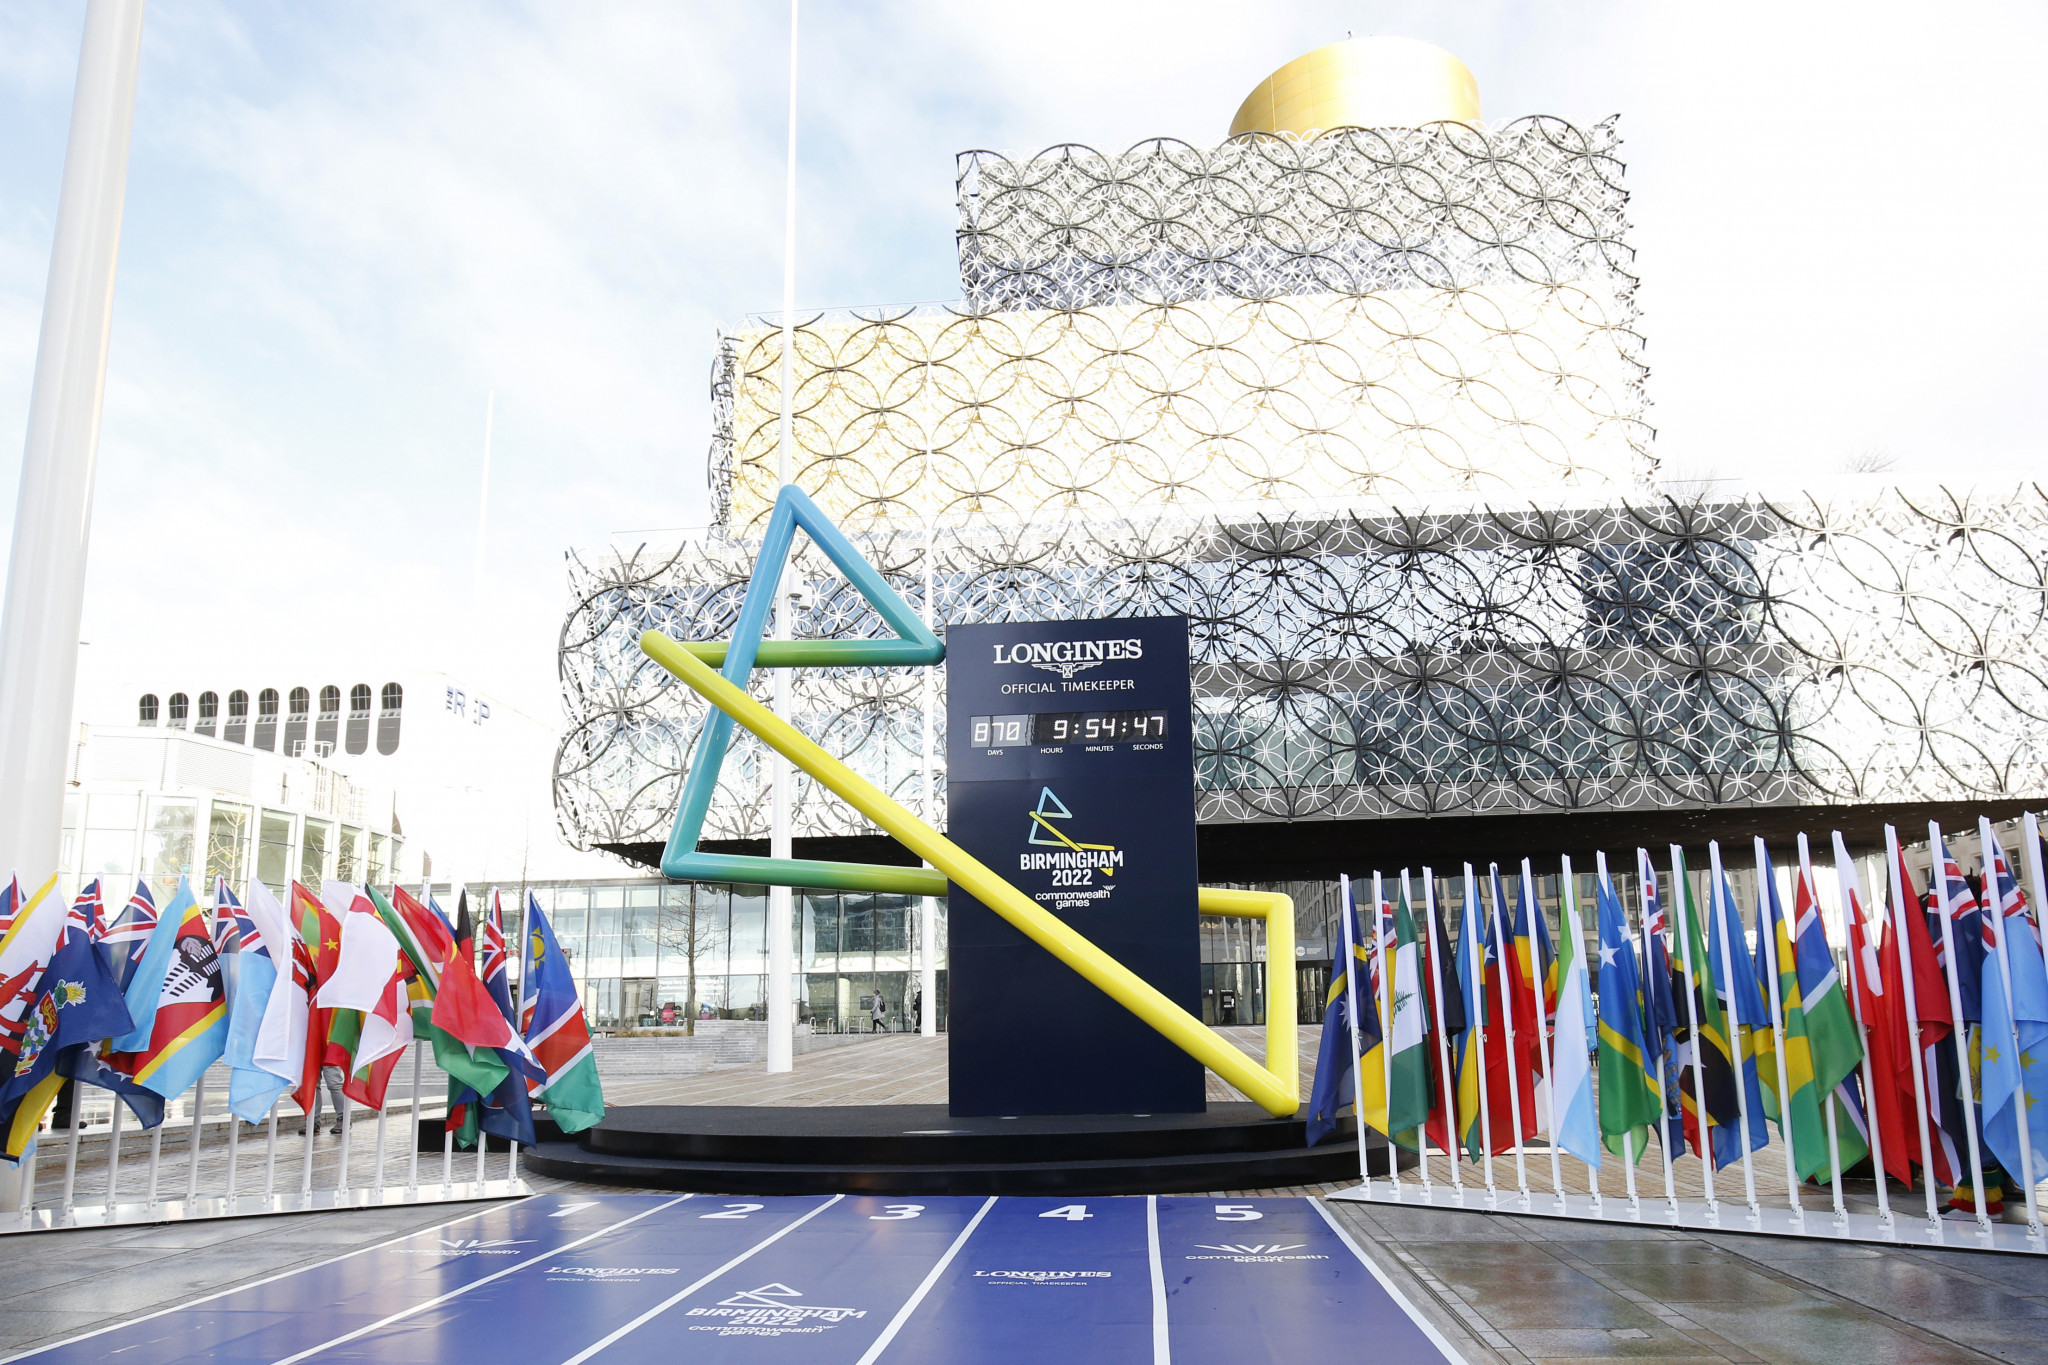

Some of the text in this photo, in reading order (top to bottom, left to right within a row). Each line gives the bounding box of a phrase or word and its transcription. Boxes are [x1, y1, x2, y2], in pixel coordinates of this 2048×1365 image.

[993, 639, 1142, 664] LONGINES
[1001, 679, 1136, 695] OFFICIAL TIMEKEEPER
[974, 722, 1021, 742] 870
[1132, 743, 1164, 751] SECONDS
[1020, 851, 1123, 870] BIRMINGHAM
[1052, 870, 1092, 886] 2022
[1035, 890, 1110, 900] commonwealth
[1055, 899, 1090, 910] games
[547, 1201, 601, 1217] 1
[698, 1203, 765, 1219] 2
[868, 1204, 926, 1221] 3
[1038, 1205, 1094, 1221] 4
[1215, 1205, 1264, 1221] 5
[544, 1267, 681, 1275] LONGINES
[973, 1270, 1112, 1278] LONGINES
[685, 1307, 868, 1319] BIRMINGHAM
[728, 1316, 803, 1326] 2022
[688, 1325, 824, 1333] commonwealth
